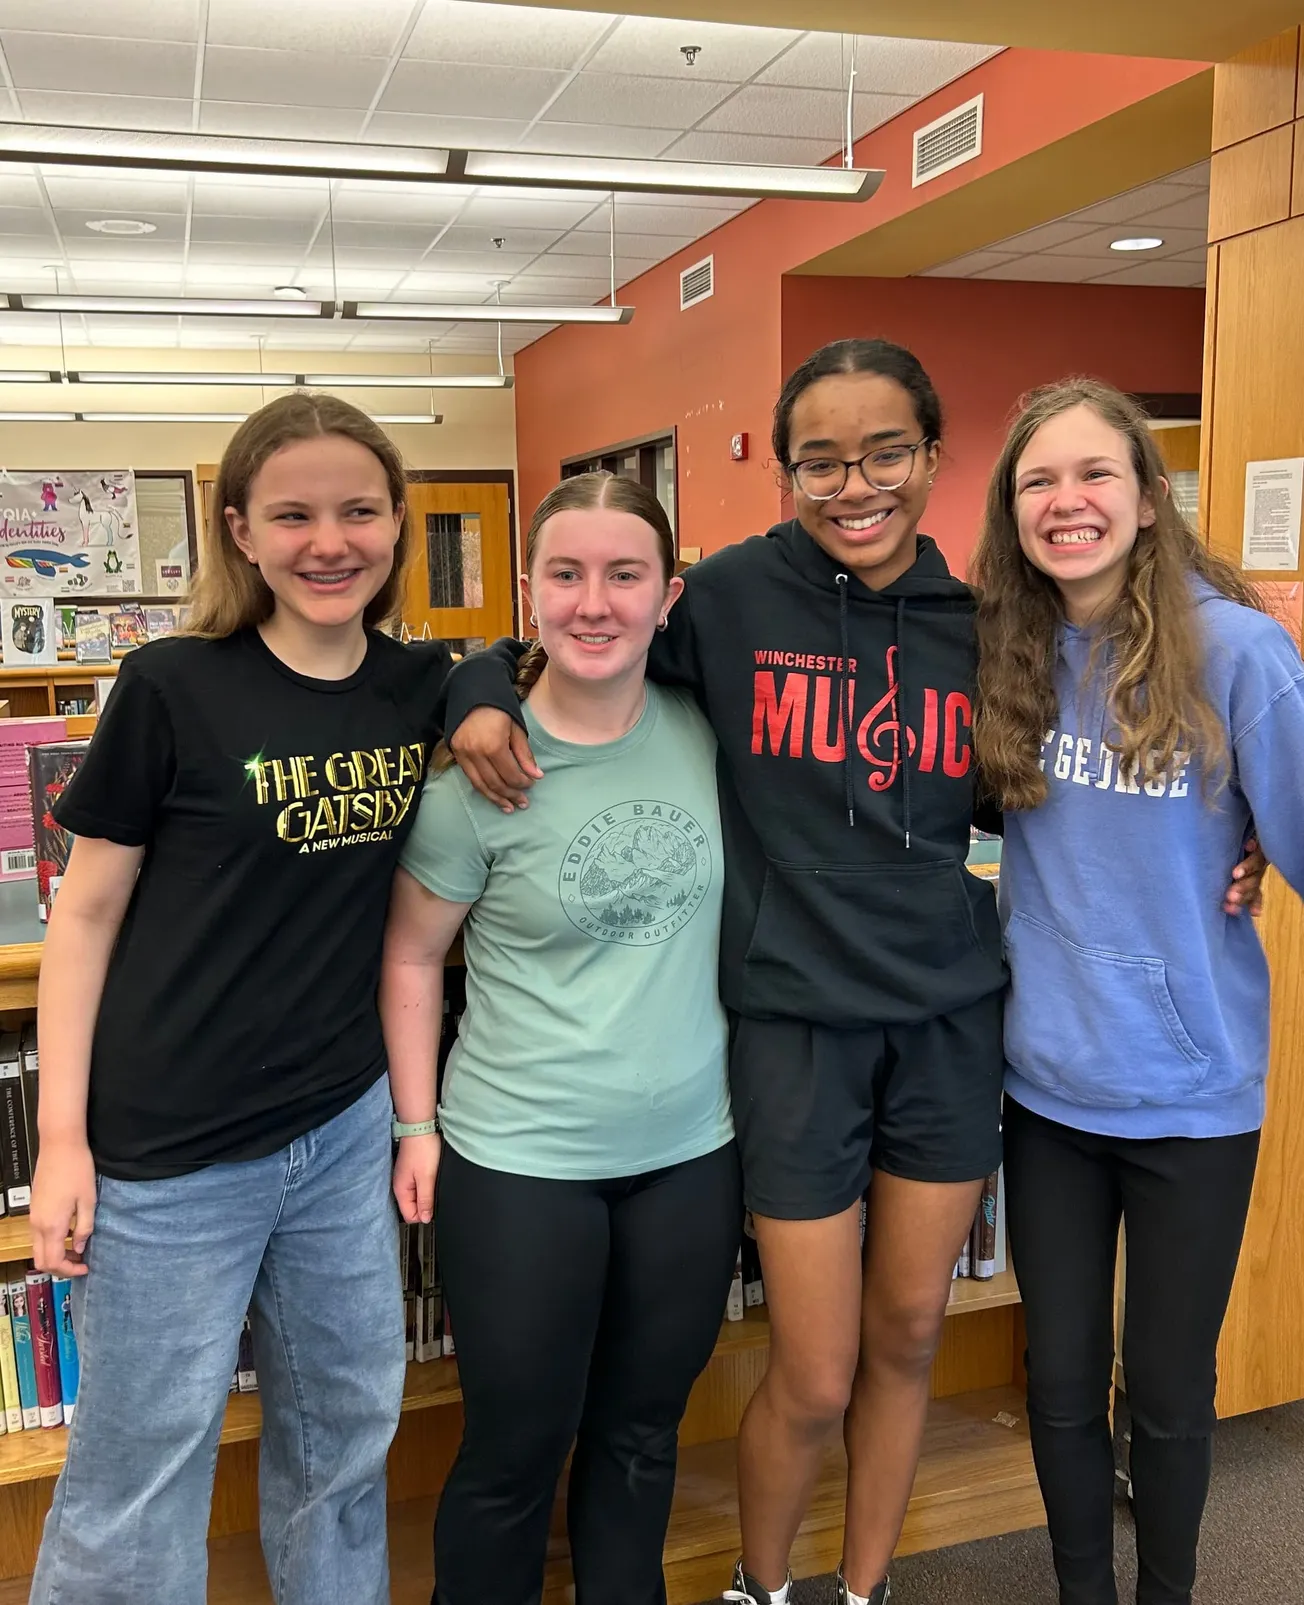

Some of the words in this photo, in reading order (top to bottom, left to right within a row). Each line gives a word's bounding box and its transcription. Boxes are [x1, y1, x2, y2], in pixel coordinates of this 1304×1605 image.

[14, 606, 41, 619] MYSTERY
[754, 650, 858, 673] WINCHESTER
[244, 756, 319, 804] THE
[325, 743, 426, 791] GREAT
[276, 786, 416, 843] GATSBY
[298, 844, 310, 854] A
[312, 838, 340, 853] NEW
[341, 830, 394, 847] MUSICAL
[563, 813, 617, 882] EDDIE
[633, 804, 705, 848] BAUER
[579, 916, 634, 939] OUTDOOR
[644, 884, 705, 939] OUTFITTER
